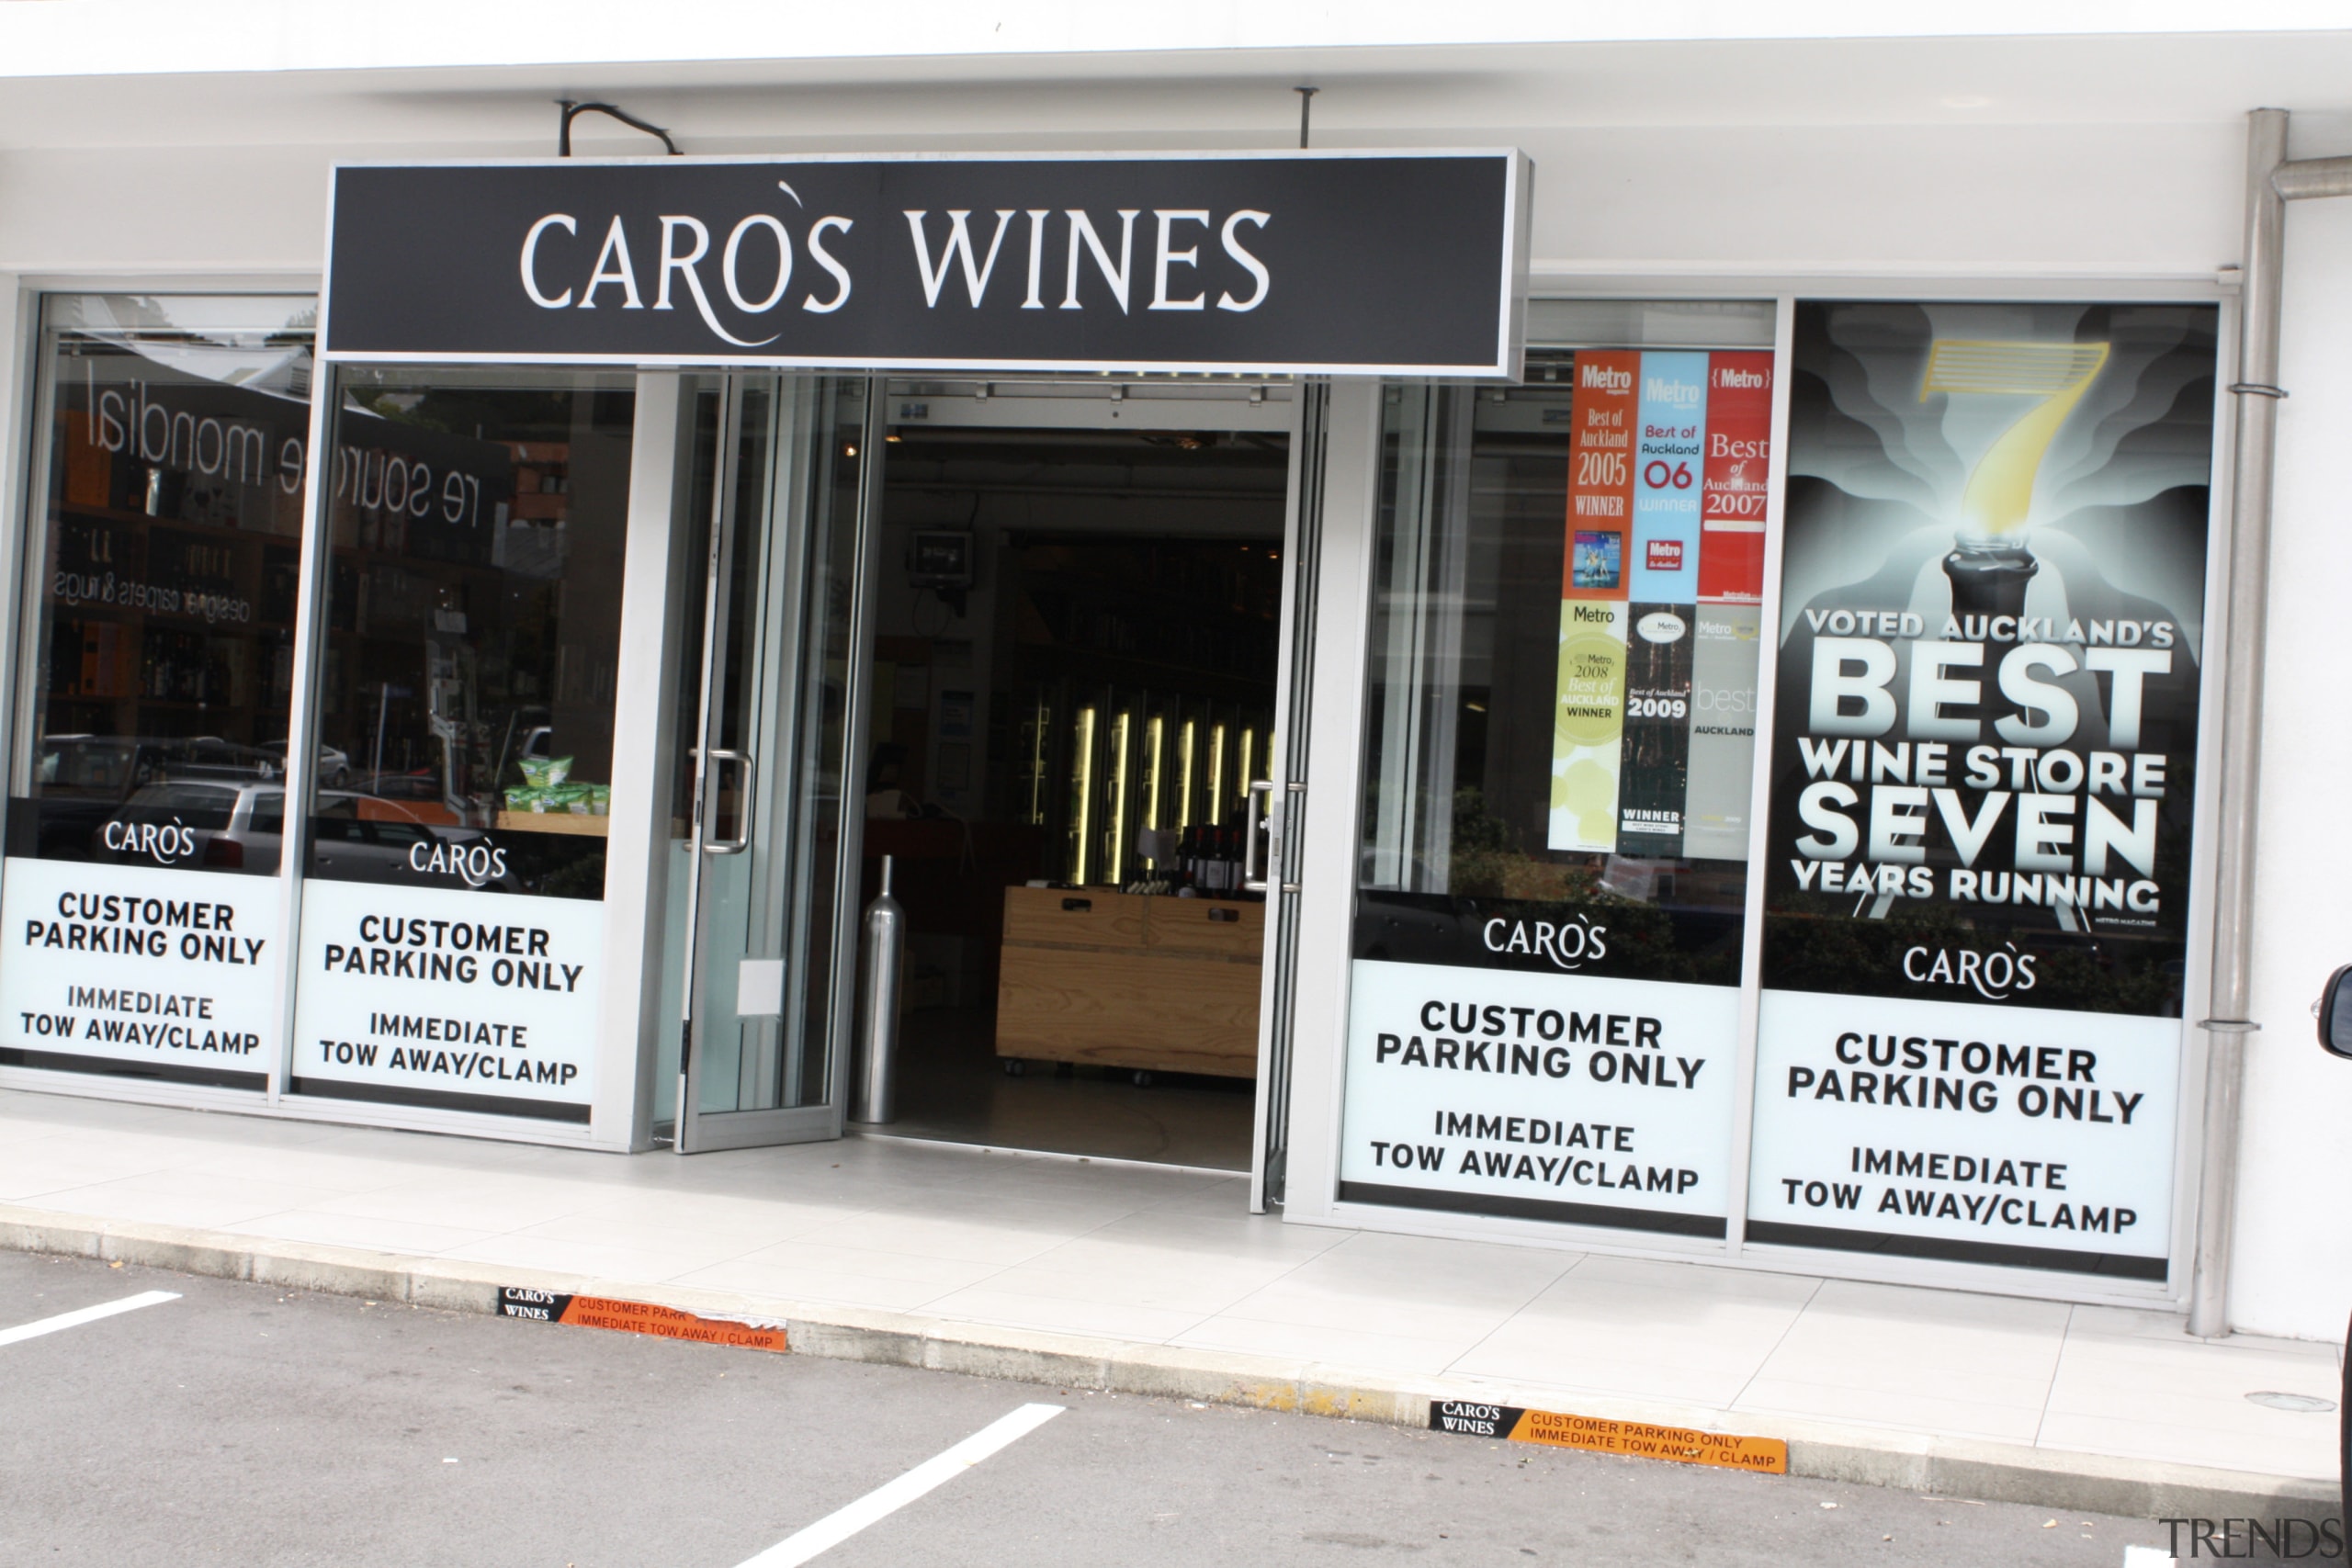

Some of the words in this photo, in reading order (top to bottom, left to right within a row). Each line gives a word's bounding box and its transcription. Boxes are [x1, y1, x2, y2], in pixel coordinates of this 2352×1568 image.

[902, 209, 1272, 316] WINES
[1582, 365, 1632, 389] Metro
[1645, 378, 1700, 403] Metro
[1721, 369, 1762, 389] Metro
[1588, 408, 1610, 427] Best
[1611, 409, 1623, 428] of
[1579, 429, 1628, 448] Auckland
[1645, 425, 1677, 439] Best
[1682, 425, 1697, 439] of
[1642, 443, 1700, 456] Auckland
[1711, 434, 1770, 459] Best
[1577, 452, 1627, 487] 2005
[1644, 460, 1693, 490] 06
[1730, 460, 1748, 476] of
[1576, 495, 1624, 516] WINNER
[1706, 493, 1768, 516] 2007
[1649, 542, 1681, 558] Metro
[1574, 605, 1615, 624] Metro
[1657, 621, 1679, 631] Metro
[1698, 621, 1732, 635] Metro
[1805, 608, 1925, 638] VOTED
[1939, 616, 2175, 649] AUCKLAND'S
[1574, 665, 1609, 679] 2008
[1588, 653, 1612, 665] Metro
[1561, 694, 1620, 706] AUCKLAND
[1567, 677, 1596, 693] Best
[1600, 677, 1617, 696] of
[1697, 680, 1757, 713] best
[1808, 637, 2173, 751] BEST
[1566, 706, 1612, 718] WINNER
[1627, 698, 1687, 719] 2009
[1694, 726, 1755, 737] AUCKLAND
[1797, 737, 1949, 785] WINE
[1964, 746, 2166, 797] STORE
[1623, 808, 1680, 823] WINNER
[1795, 781, 2159, 879] SEVEN
[1790, 859, 1935, 900] YEARS
[1950, 869, 2160, 913] RUNNING
[58, 892, 235, 931] CUSTOMER
[25, 919, 168, 958] PARKING
[180, 933, 266, 966] ONLY
[359, 916, 551, 957] CUSTOMER
[324, 944, 478, 984] PARKING
[491, 958, 584, 994] ONLY
[67, 985, 214, 1020] IMMEDIATE
[20, 1012, 76, 1038] TOW
[85, 1016, 260, 1055] AWAY/CLAMP
[369, 1012, 528, 1049] IMMEDIATE
[1420, 1000, 1664, 1049] CUSTOMER
[319, 1040, 379, 1067] TOW
[389, 1045, 579, 1087] AWAY/CLAMP
[1375, 1033, 1572, 1079] PARKING
[1589, 1050, 1706, 1089] ONLY
[1835, 1032, 2098, 1083] CUSTOMER
[1787, 1066, 1998, 1113] PARKING
[2018, 1085, 2145, 1125] ONLY
[1434, 1111, 1635, 1153] IMMEDIATE
[1370, 1141, 1445, 1171] TOW
[1459, 1149, 1700, 1195] AWAY/CLAMP
[1850, 1146, 2068, 1190] IMMEDIATE
[1781, 1179, 1863, 1210] TOW
[1877, 1188, 2138, 1235] AWAY/CLAMP
[505, 1287, 555, 1304] CARO'S
[578, 1297, 650, 1318] CUSTOMER
[504, 1303, 549, 1321] WINES
[577, 1314, 647, 1333] IMMEDIATE
[650, 1322, 679, 1337] TOW
[681, 1325, 718, 1343] AWAY
[727, 1332, 774, 1349] CLAMP
[1442, 1402, 1501, 1422] CARO'S
[1442, 1416, 1495, 1436] WINES
[1531, 1413, 1619, 1434] CUSTOMER
[1624, 1424, 1695, 1445] PARKING
[1700, 1432, 1743, 1450] ONLY
[1530, 1427, 1616, 1449] IMMEDIATE
[1622, 1438, 1657, 1453] TOW
[1659, 1442, 1705, 1461] AWAY
[1719, 1450, 1777, 1468] CLAMP
